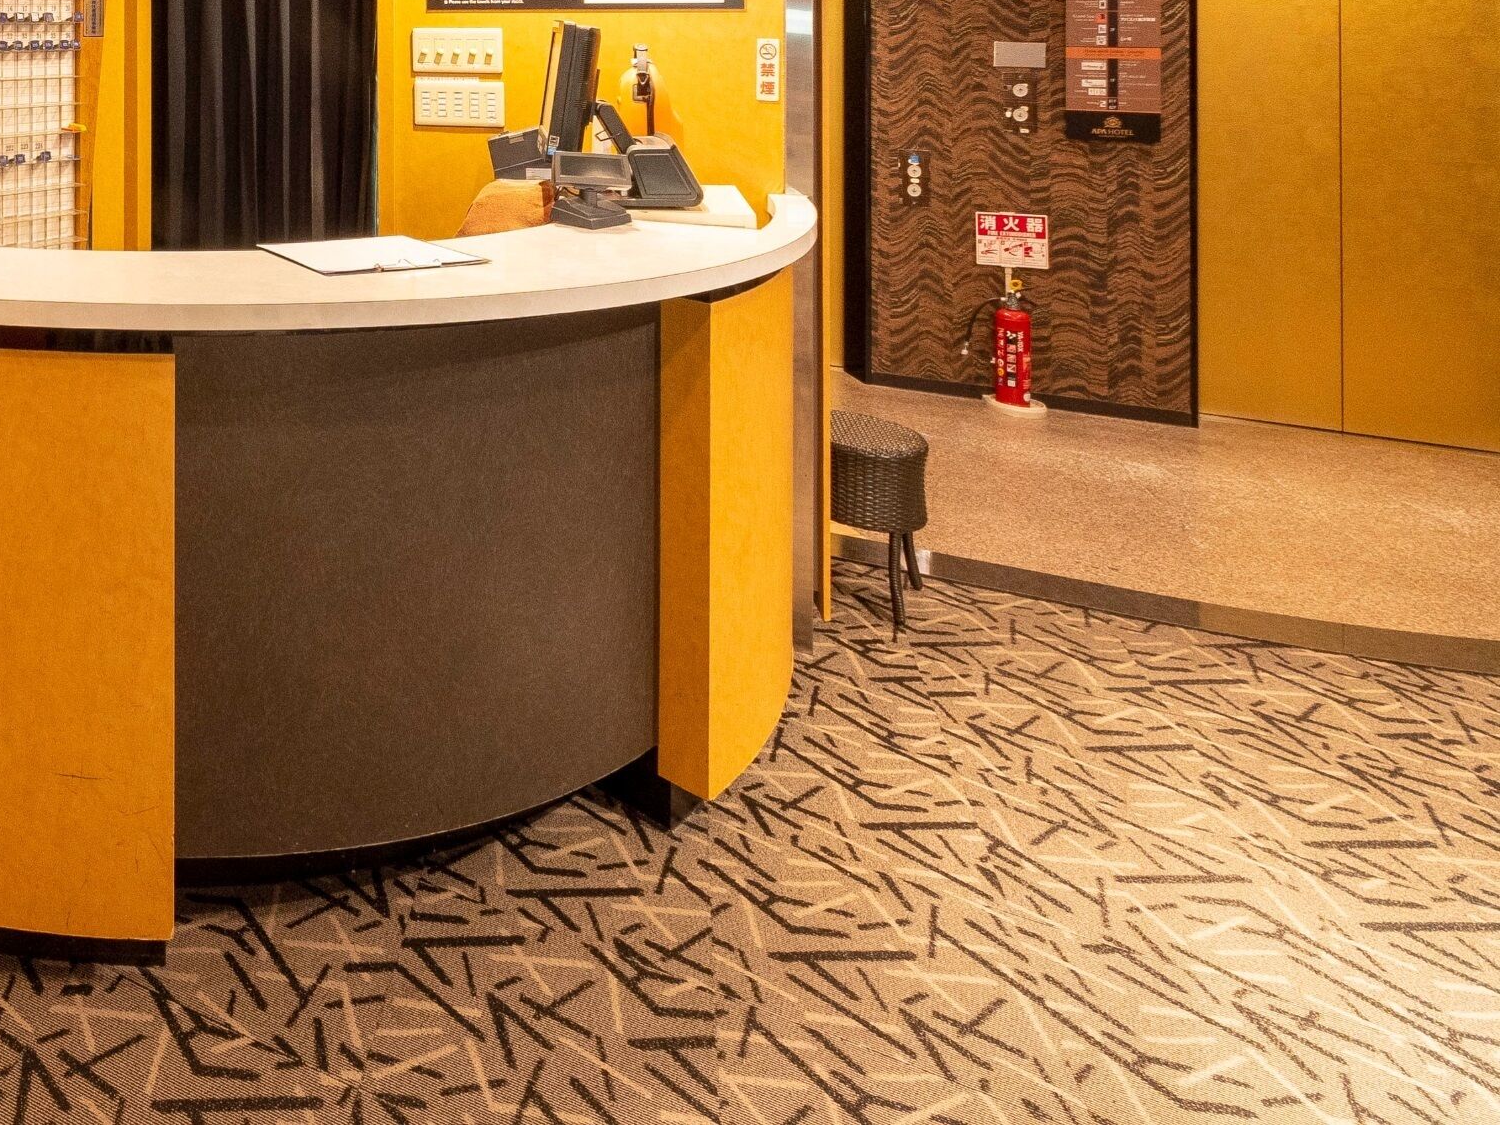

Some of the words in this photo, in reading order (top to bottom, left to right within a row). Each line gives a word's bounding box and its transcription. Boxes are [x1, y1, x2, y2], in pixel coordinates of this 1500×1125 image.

[760, 63, 775, 94] 禁煙
[980, 215, 1044, 233] 消火器
